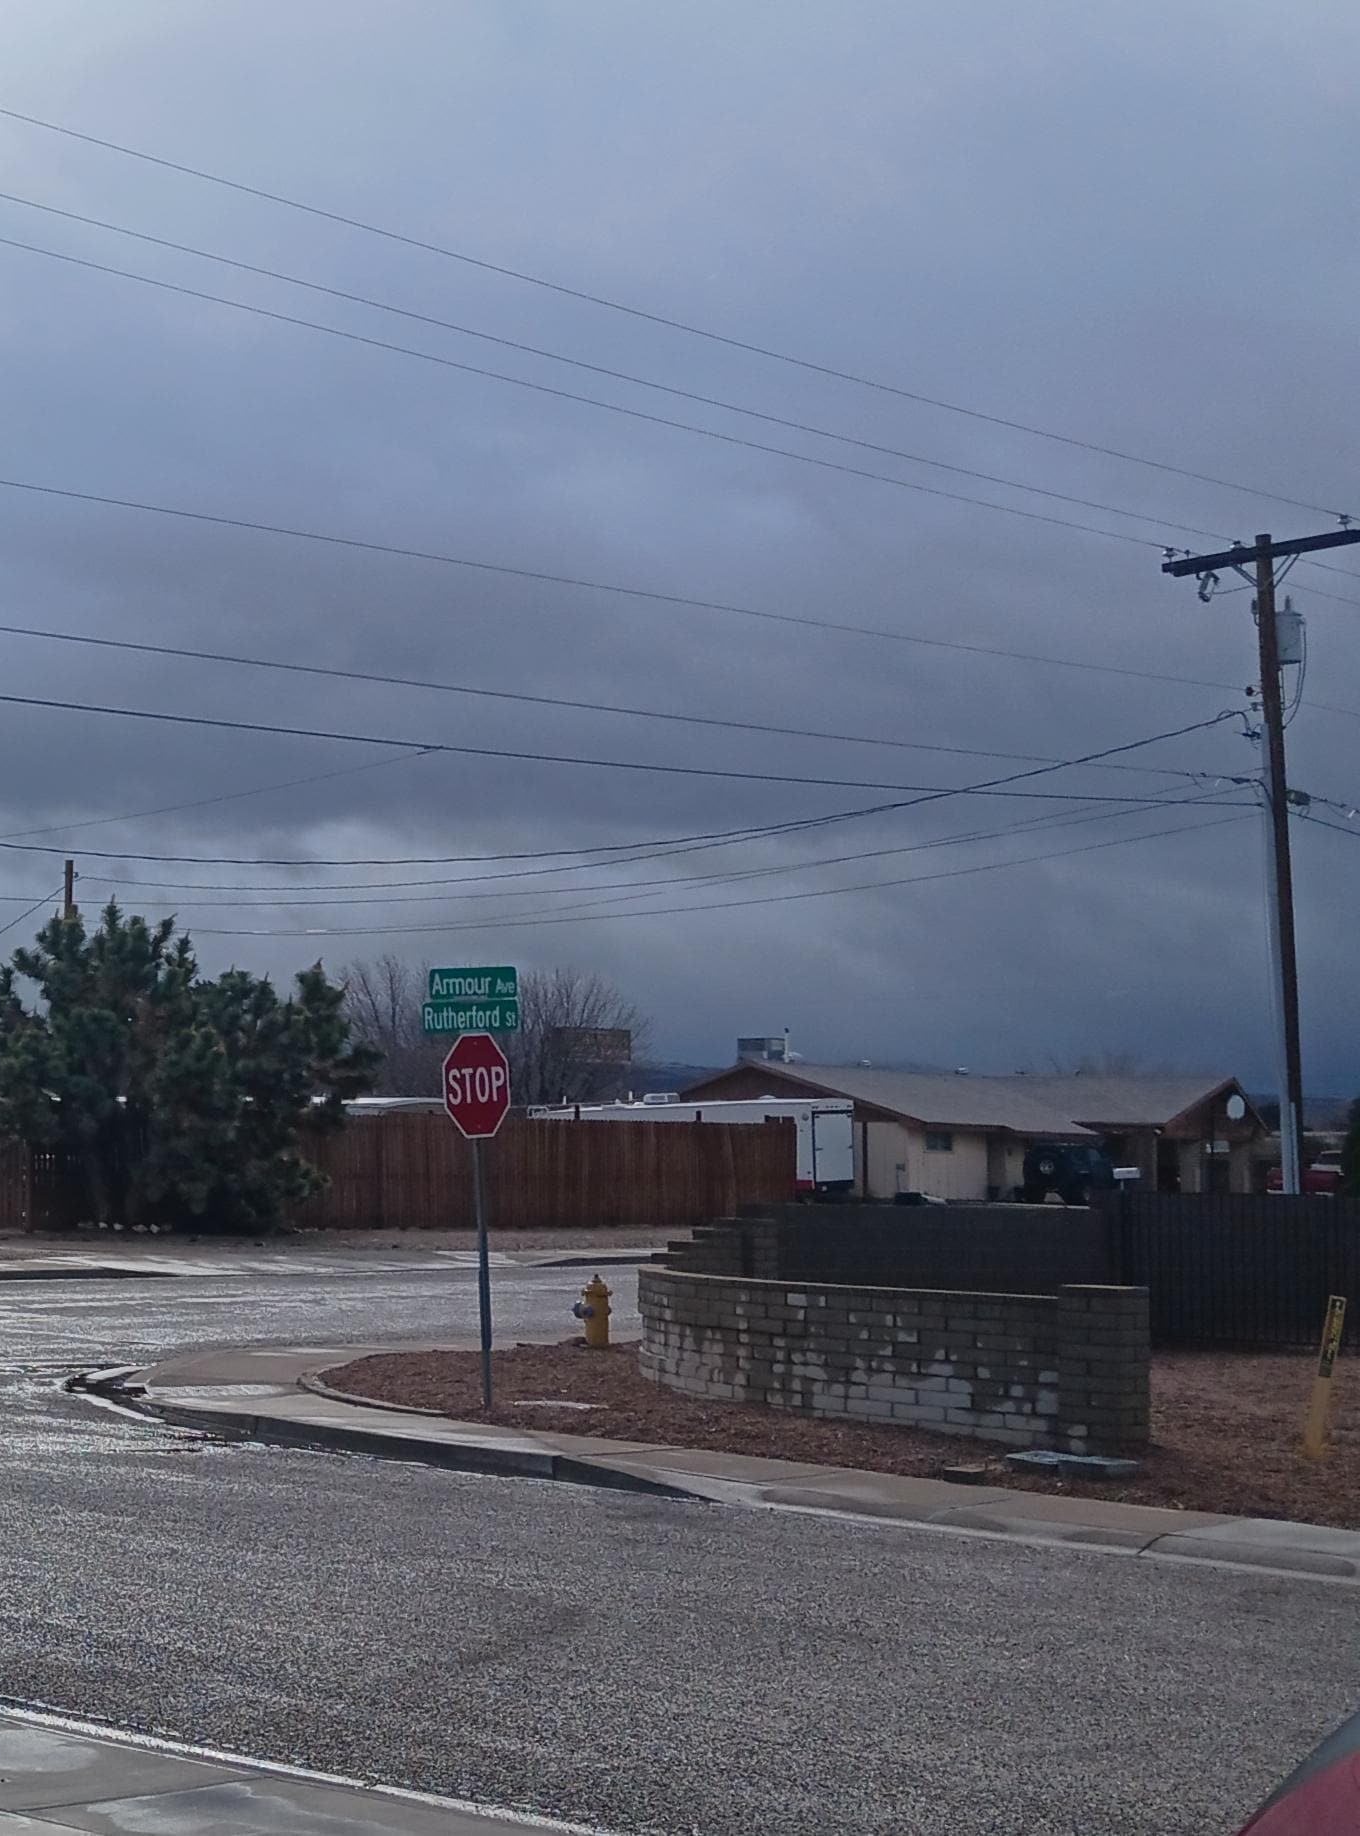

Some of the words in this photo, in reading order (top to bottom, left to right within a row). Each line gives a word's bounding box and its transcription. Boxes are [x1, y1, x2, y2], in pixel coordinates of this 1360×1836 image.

[432, 973, 491, 995] Armour
[495, 979, 515, 993] Ave
[424, 1005, 500, 1030] Rutherford
[505, 1010, 517, 1027] St
[448, 1066, 505, 1105] STOP
